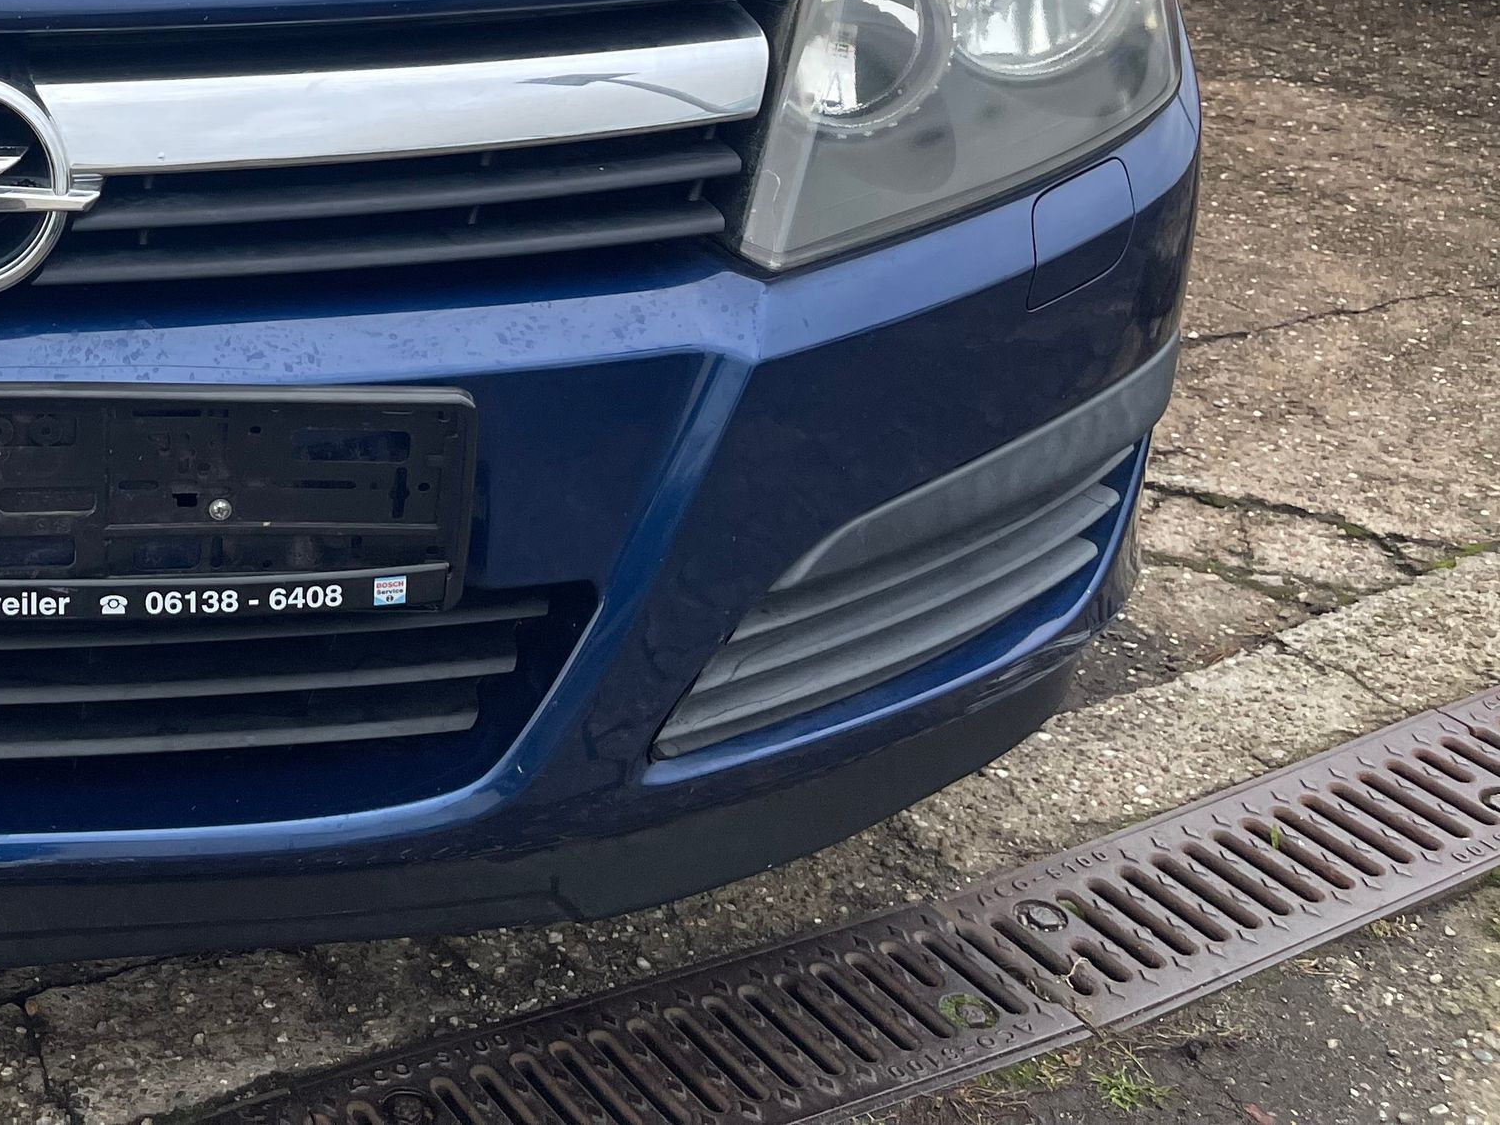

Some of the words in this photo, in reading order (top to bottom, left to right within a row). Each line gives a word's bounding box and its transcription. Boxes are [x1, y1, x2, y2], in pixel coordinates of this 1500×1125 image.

[376, 580, 404, 589] BOSCH
[144, 590, 239, 615] 06138
[268, 585, 344, 610] 6408
